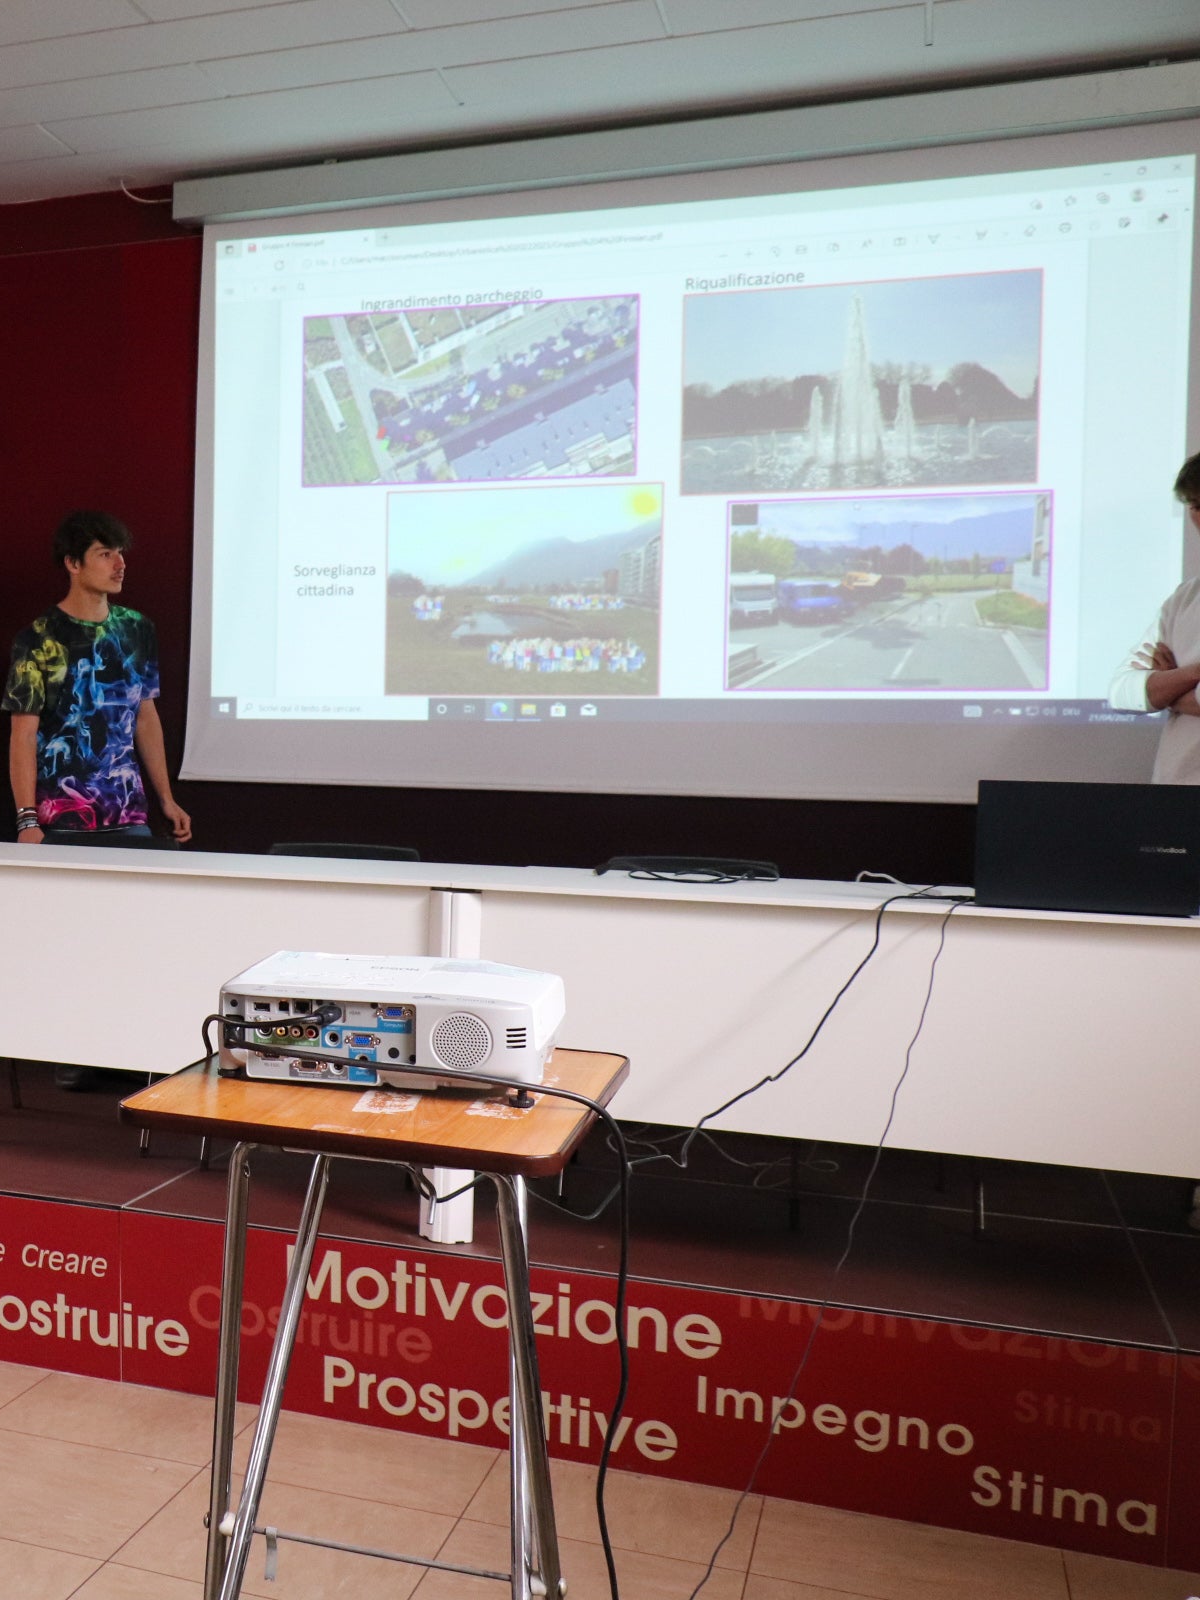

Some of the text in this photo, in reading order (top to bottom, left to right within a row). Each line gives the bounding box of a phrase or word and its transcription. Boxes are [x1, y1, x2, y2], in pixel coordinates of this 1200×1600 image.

[685, 271, 806, 292] Riqualificazione
[360, 287, 544, 312] Ingrandimento parcheggio
[293, 563, 377, 579] Sorveglianza
[296, 583, 355, 597] cittadina
[21, 1243, 108, 1278] Creare
[286, 1244, 723, 1360] Motivazione
[696, 1375, 974, 1456] Impegno
[1013, 1390, 1162, 1444] Stima
[971, 1465, 1158, 1537] Stima
